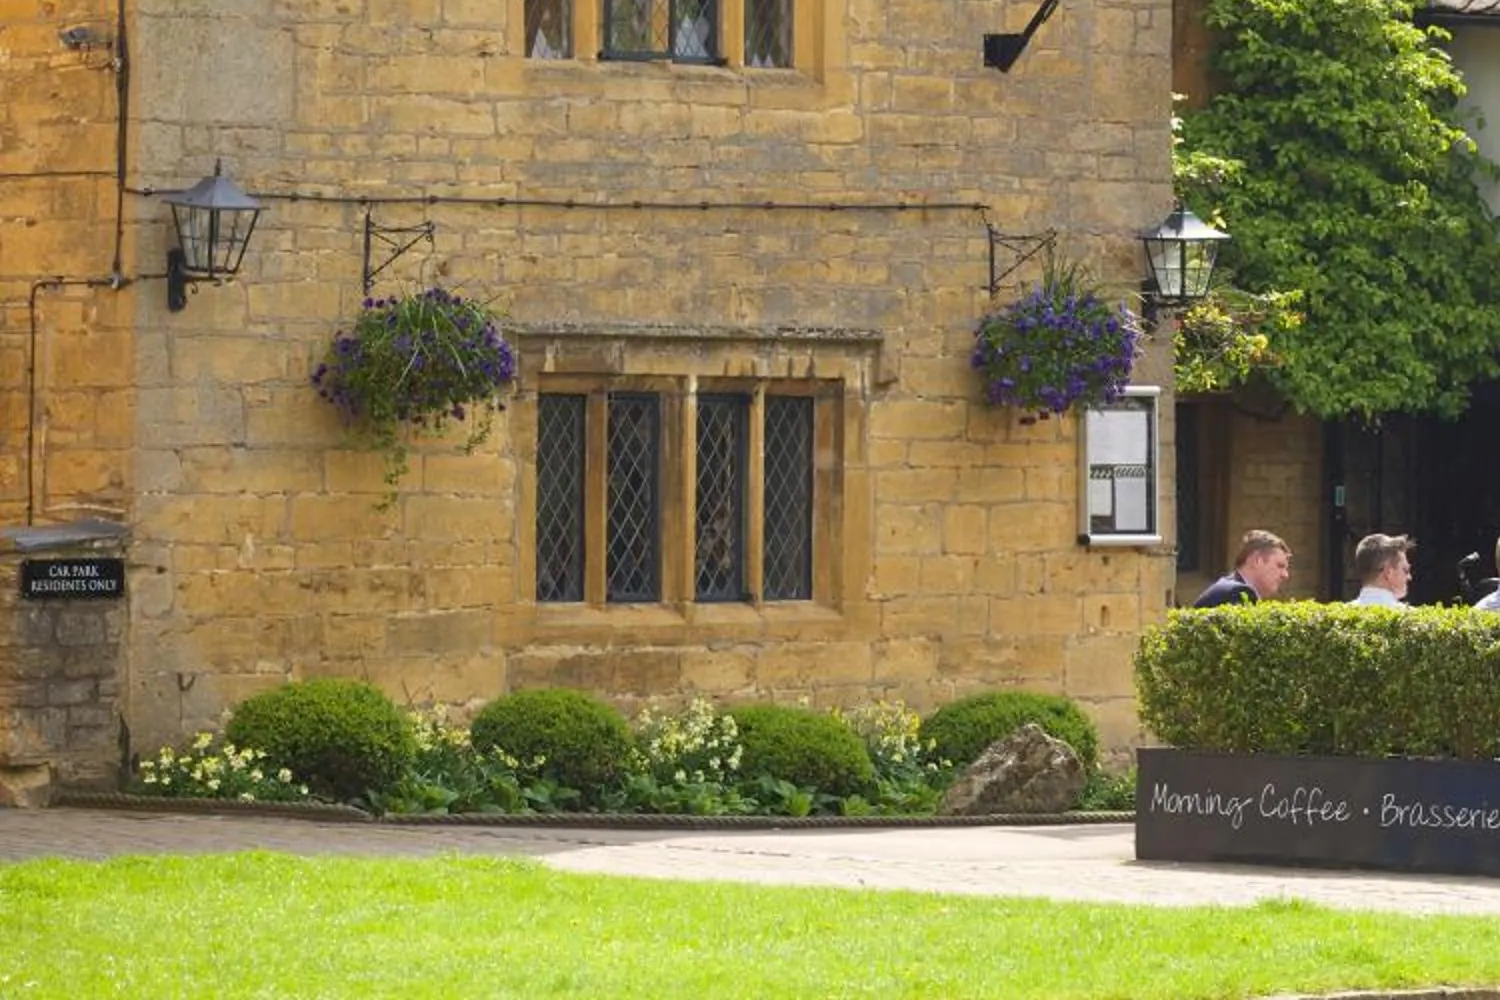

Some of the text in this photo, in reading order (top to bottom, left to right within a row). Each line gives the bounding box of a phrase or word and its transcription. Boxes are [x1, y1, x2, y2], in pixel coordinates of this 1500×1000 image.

[48, 565, 100, 577] CAR PARK
[31, 580, 117, 591] RESIDENTS ONLY
[1150, 783, 1253, 830] Morning
[1259, 783, 1350, 826] Coffee
